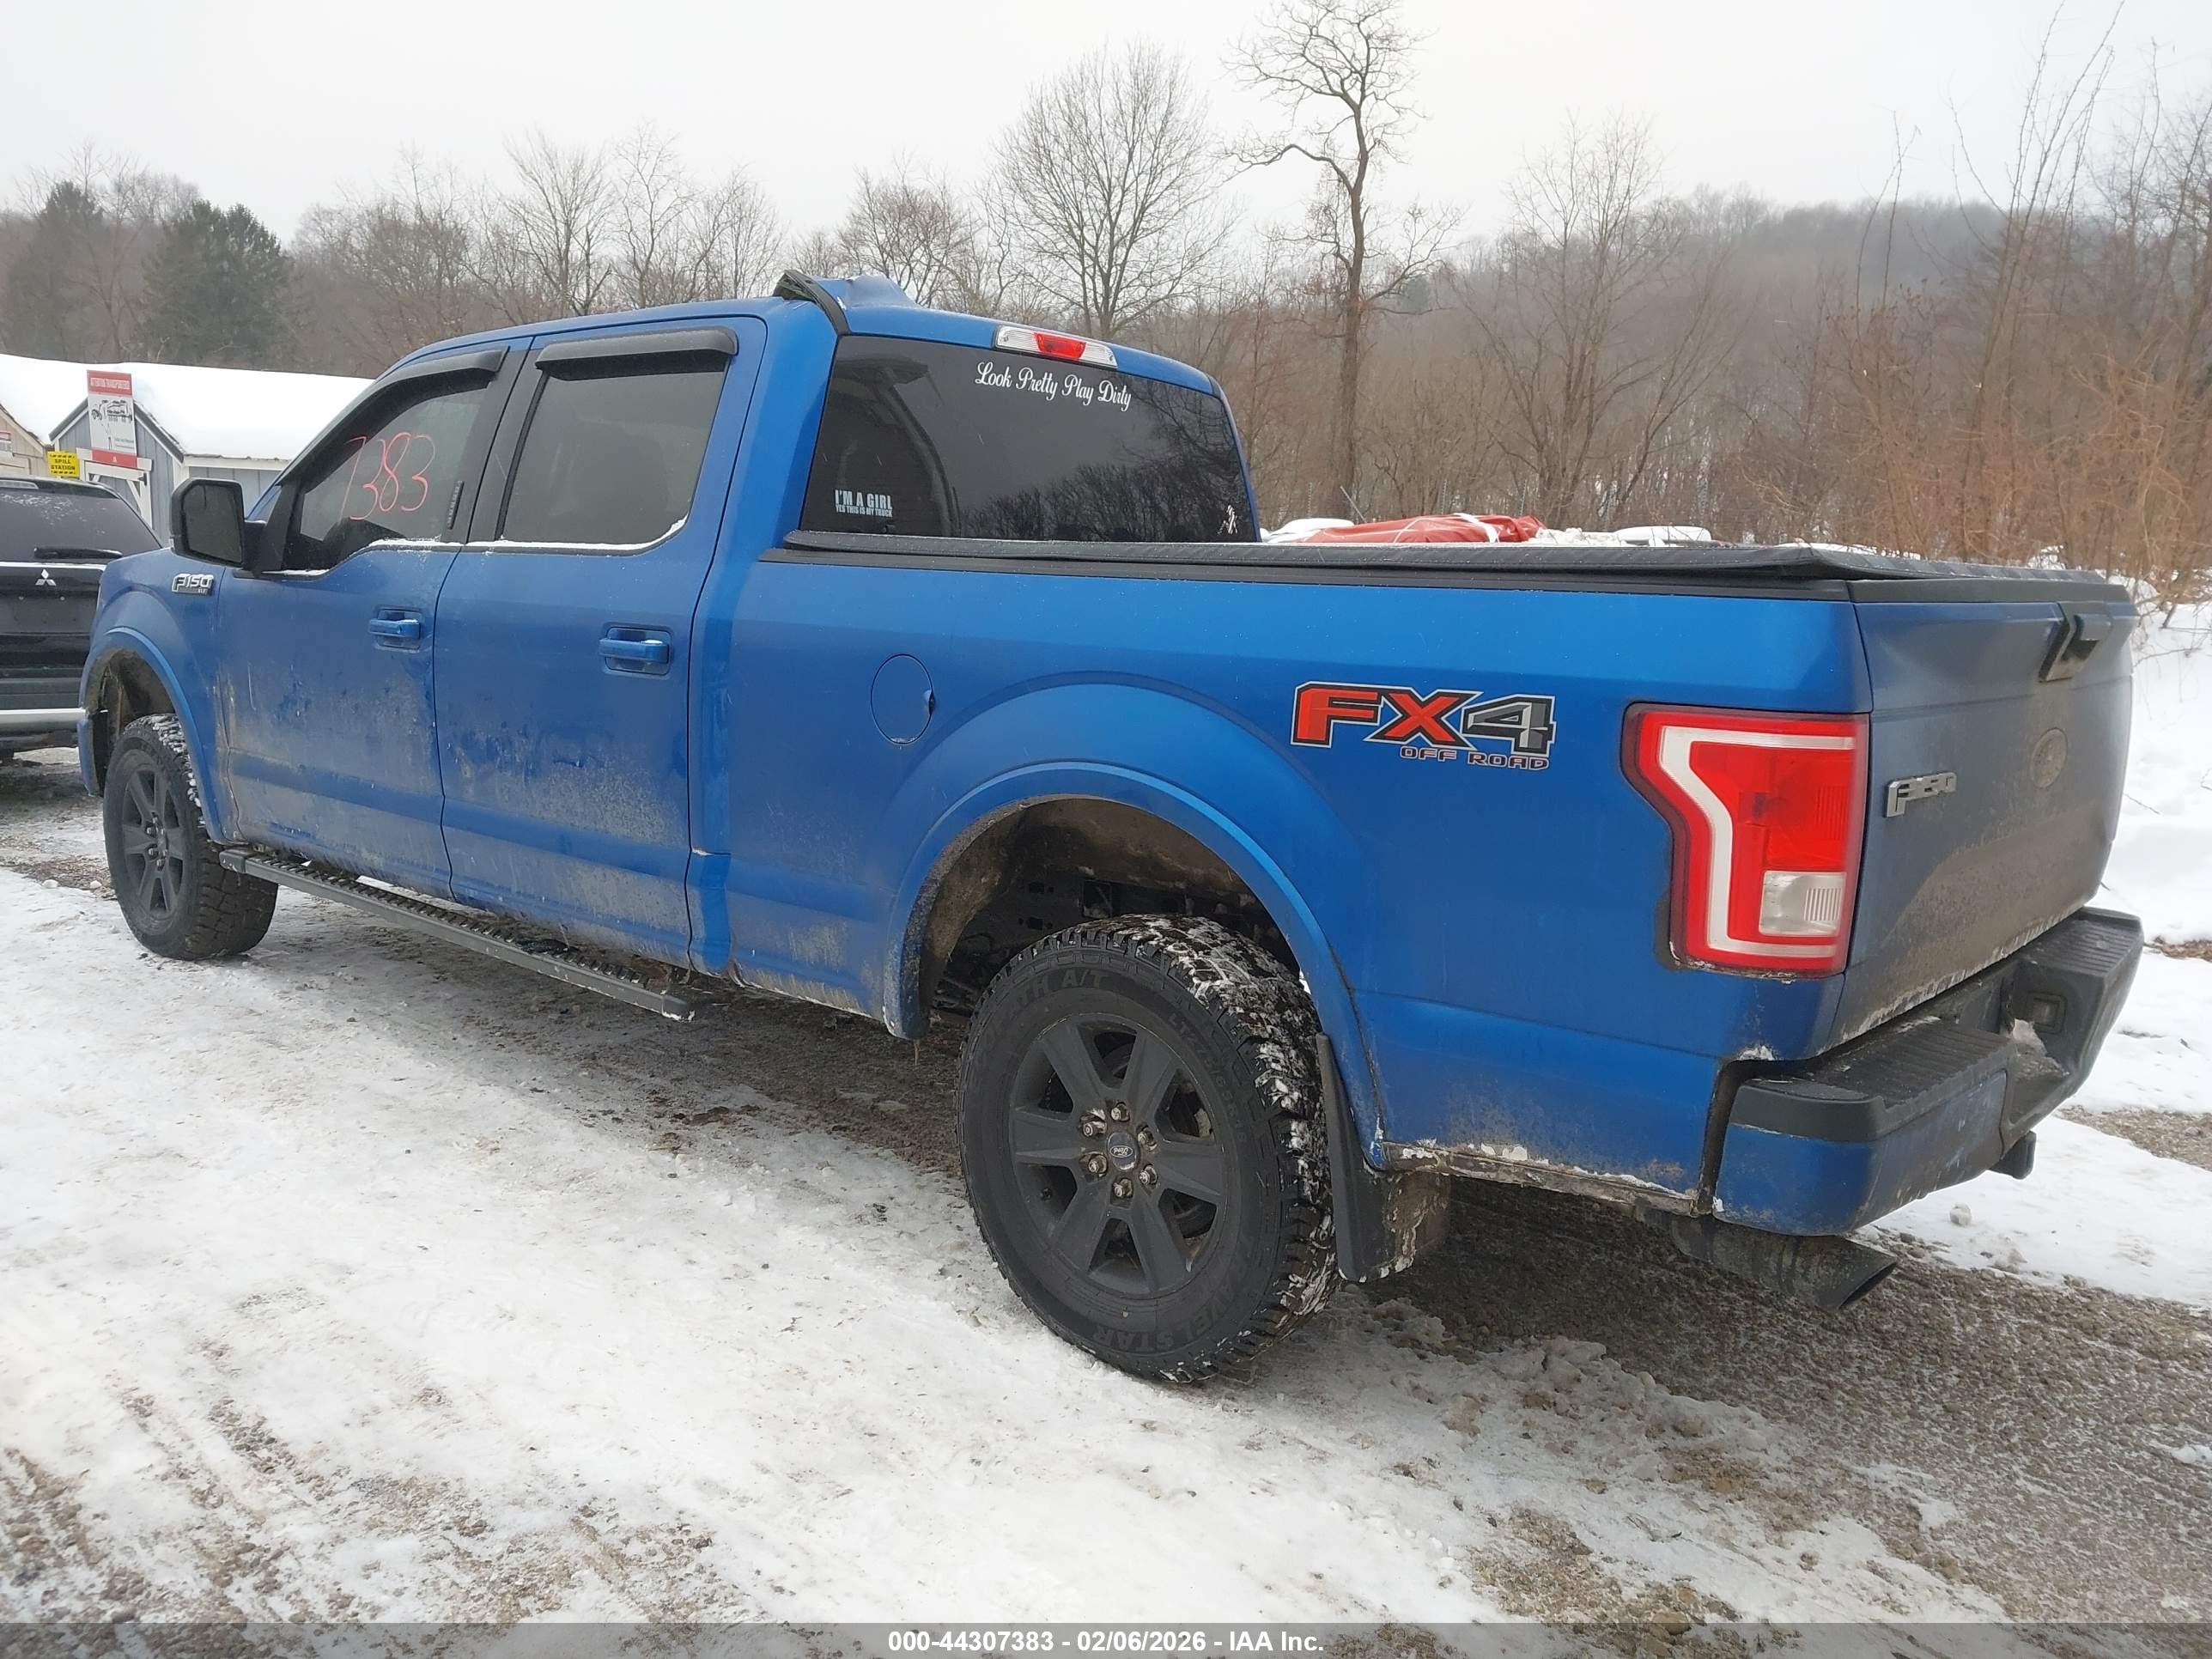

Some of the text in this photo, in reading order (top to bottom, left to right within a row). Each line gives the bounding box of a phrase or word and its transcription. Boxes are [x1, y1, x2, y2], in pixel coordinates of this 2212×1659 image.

[975, 362, 1132, 412] Look Pretty Play Dirty
[337, 432, 436, 526] 7383
[836, 489, 893, 510] I'M A GIRL
[836, 504, 846, 513] YES
[847, 505, 859, 514] THIS
[860, 507, 866, 515] IS
[875, 507, 893, 518] TRUCK
[1291, 681, 1556, 750] FX4
[1400, 745, 1550, 771] OFF ROAD
